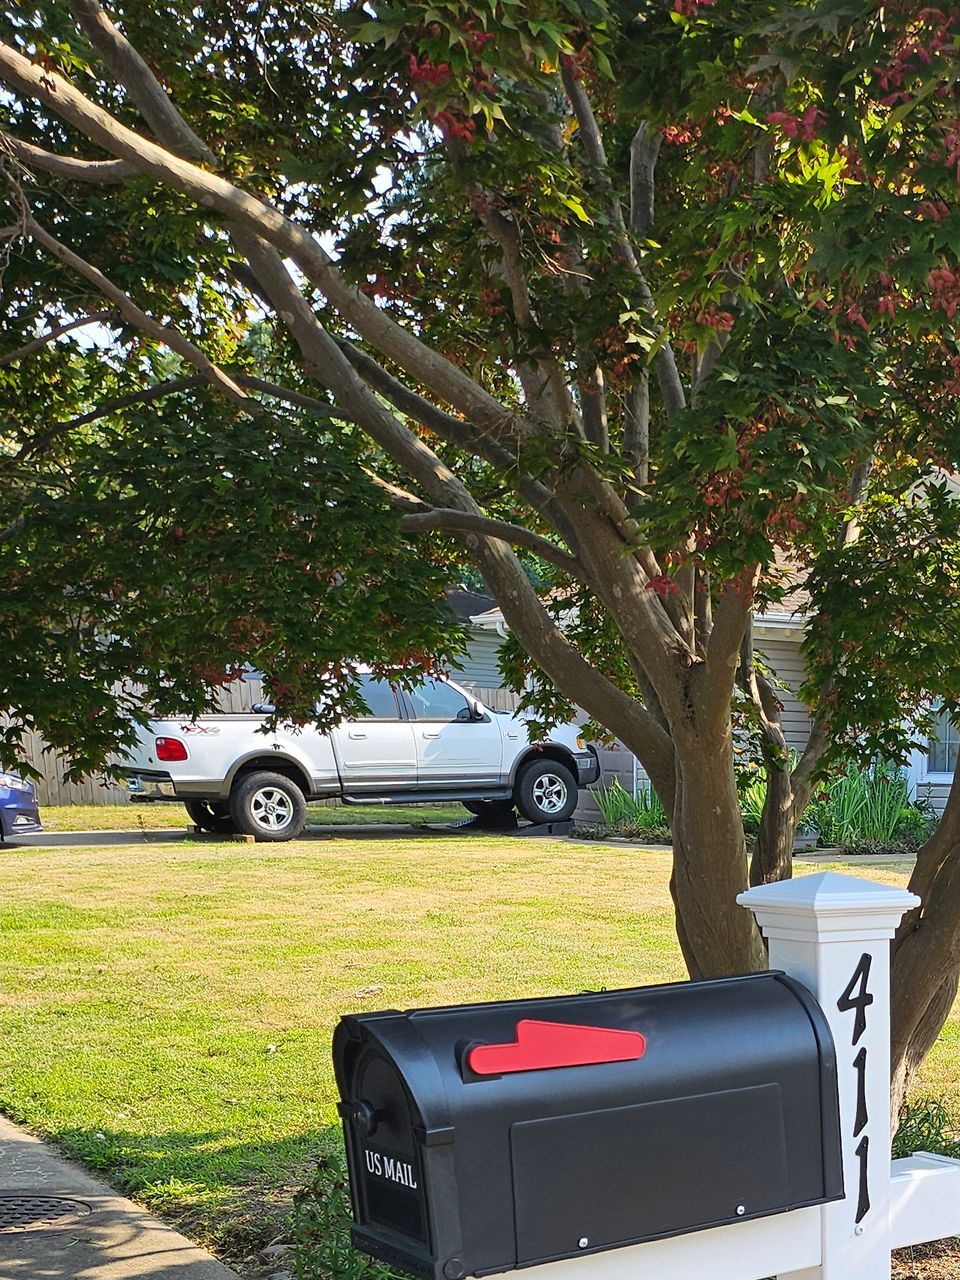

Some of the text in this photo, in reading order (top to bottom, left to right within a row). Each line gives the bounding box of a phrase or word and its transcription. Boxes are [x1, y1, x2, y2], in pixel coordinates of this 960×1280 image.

[837, 953, 874, 1223] 411
[365, 1150, 417, 1189] US MAIL
